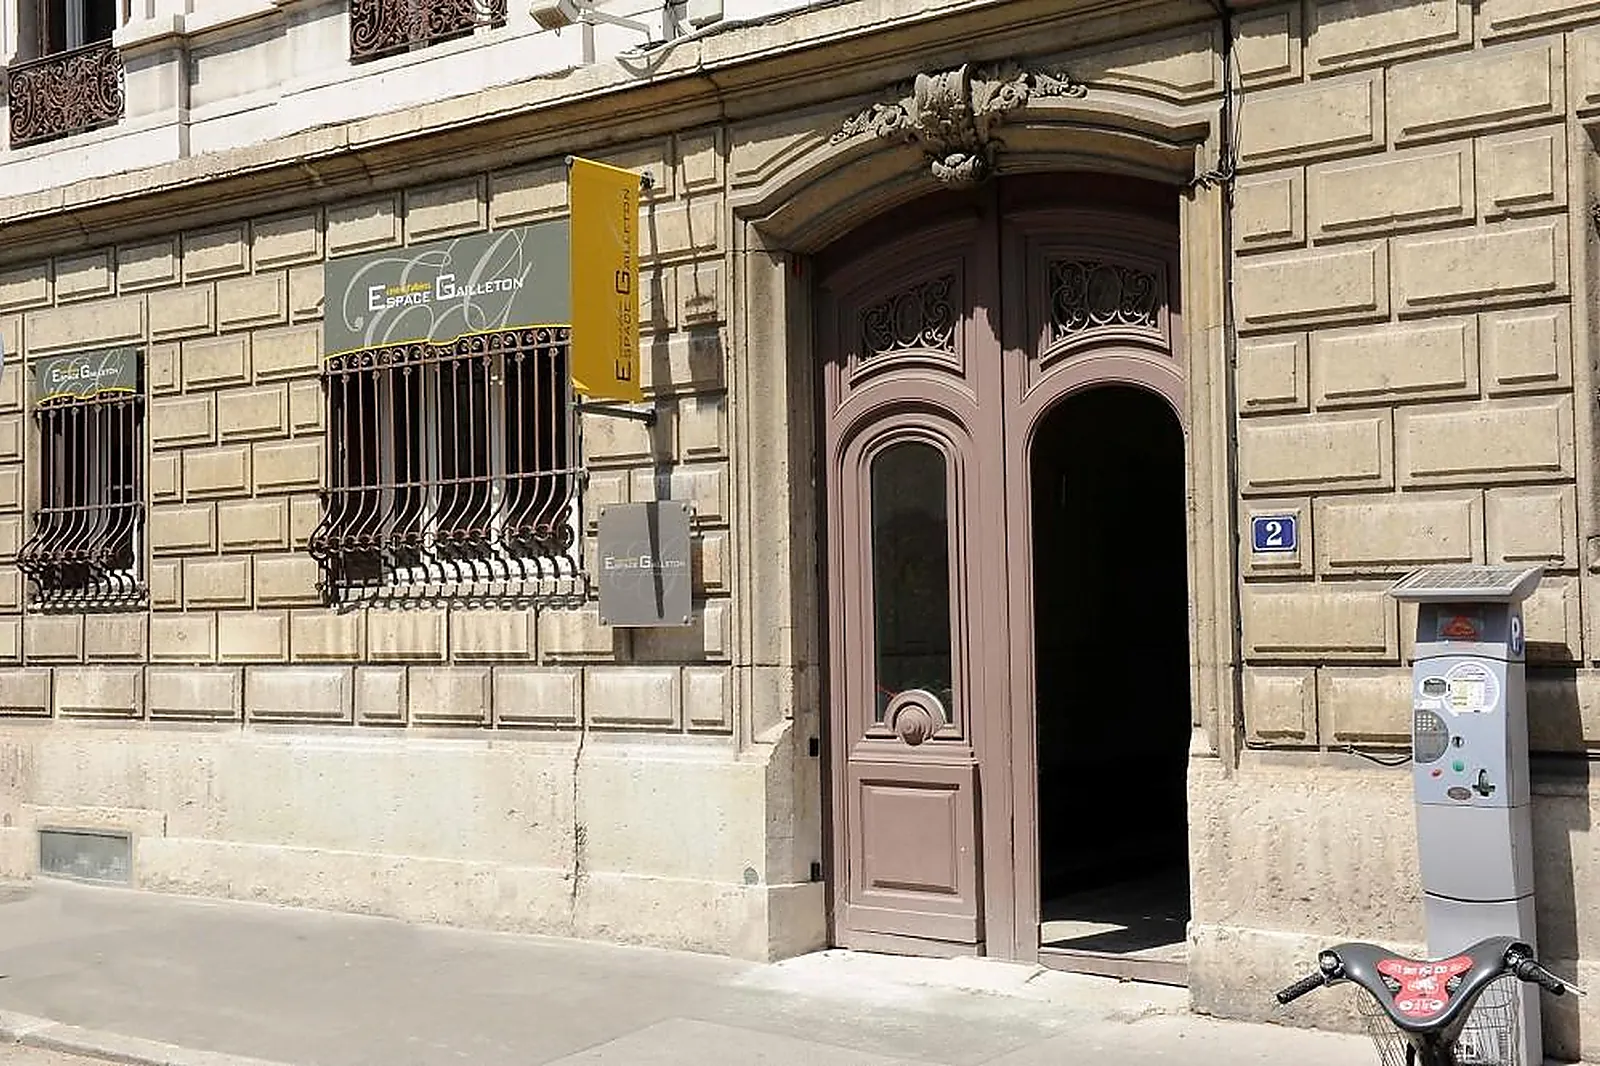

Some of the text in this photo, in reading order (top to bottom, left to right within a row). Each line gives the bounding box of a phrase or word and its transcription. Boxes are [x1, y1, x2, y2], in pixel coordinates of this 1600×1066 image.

[368, 284, 431, 312] ESPACE
[436, 273, 523, 301] GAILLETON
[1266, 521, 1282, 546] 2
